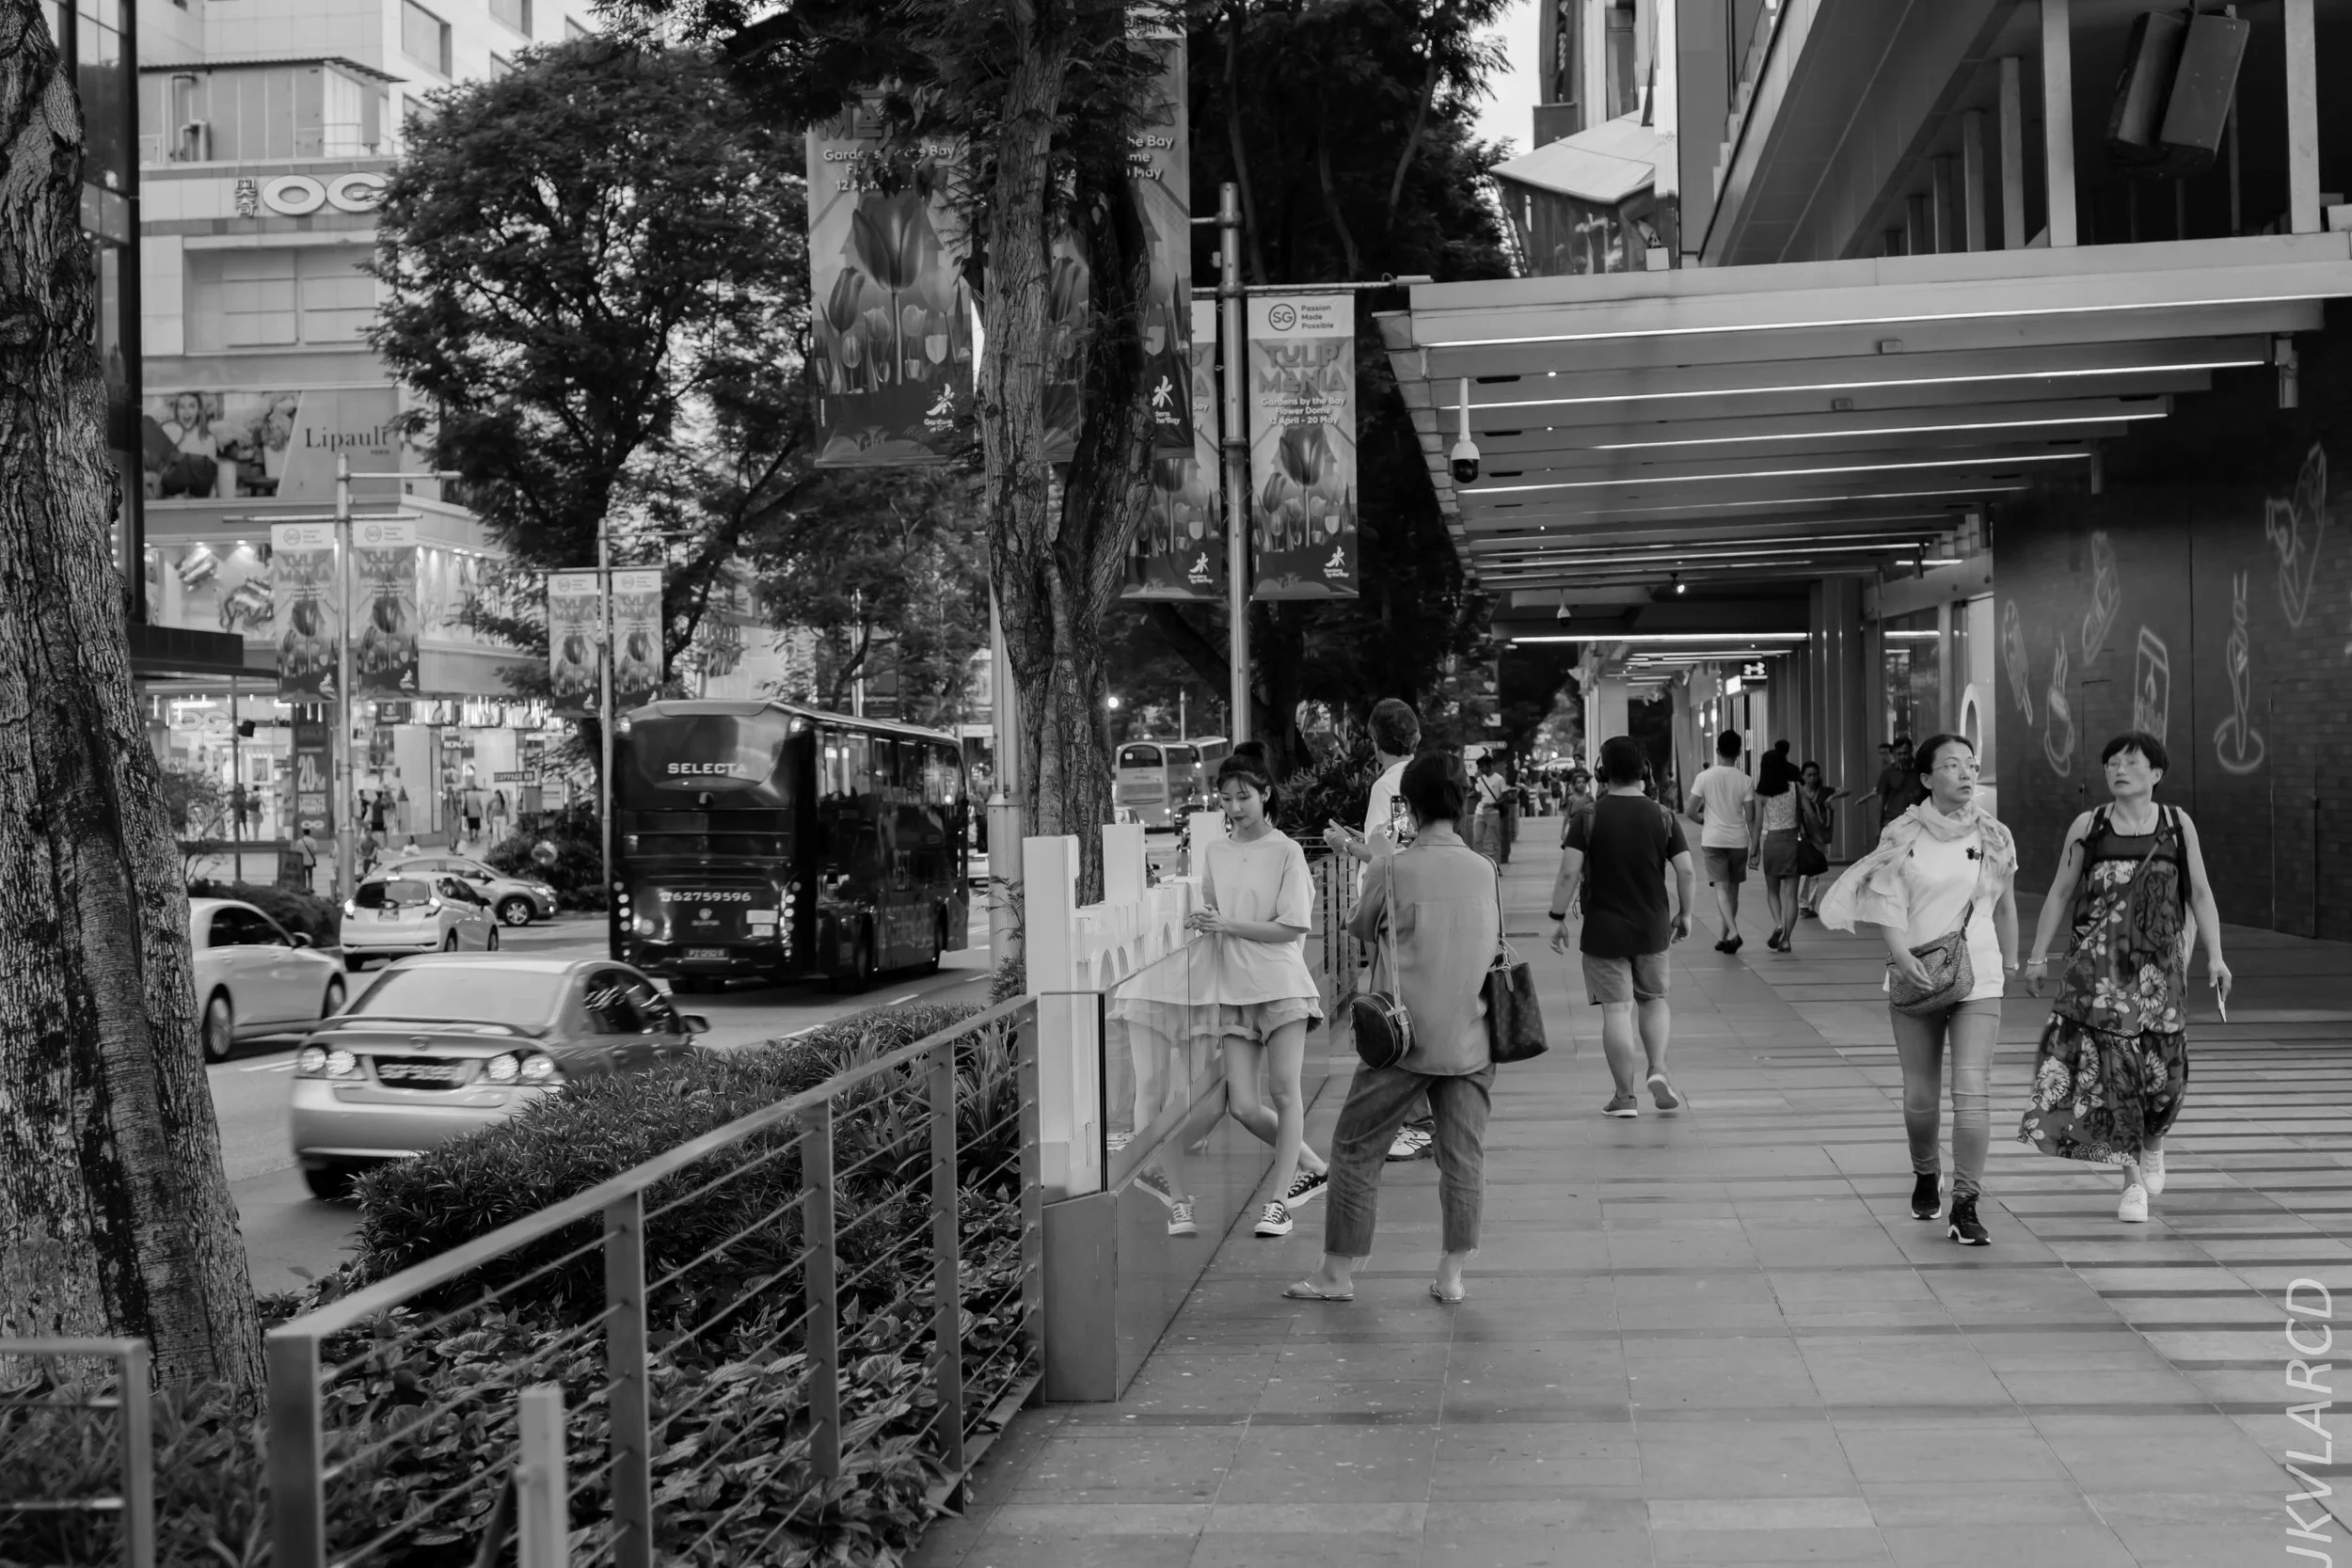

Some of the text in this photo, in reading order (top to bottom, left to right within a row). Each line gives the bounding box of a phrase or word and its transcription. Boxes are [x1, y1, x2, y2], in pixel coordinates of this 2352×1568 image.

[1147, 135, 1173, 150] Bay
[929, 144, 955, 159] Bay
[834, 180, 849, 191] 12
[262, 172, 389, 216] OG
[1301, 304, 1332, 312] Passion
[1272, 311, 1294, 324] SG
[1264, 344, 1340, 368] TULIP
[1258, 370, 1347, 393] MANIA
[1260, 396, 1347, 407] Gardens by the Bay
[1275, 406, 1332, 416] Flower Dome
[1279, 415, 1300, 426] April
[1307, 416, 1318, 424] 20
[1320, 414, 1339, 425] May
[305, 425, 389, 452] Lipault
[667, 762, 748, 775] SELECTA
[673, 892, 752, 902] 62759596
